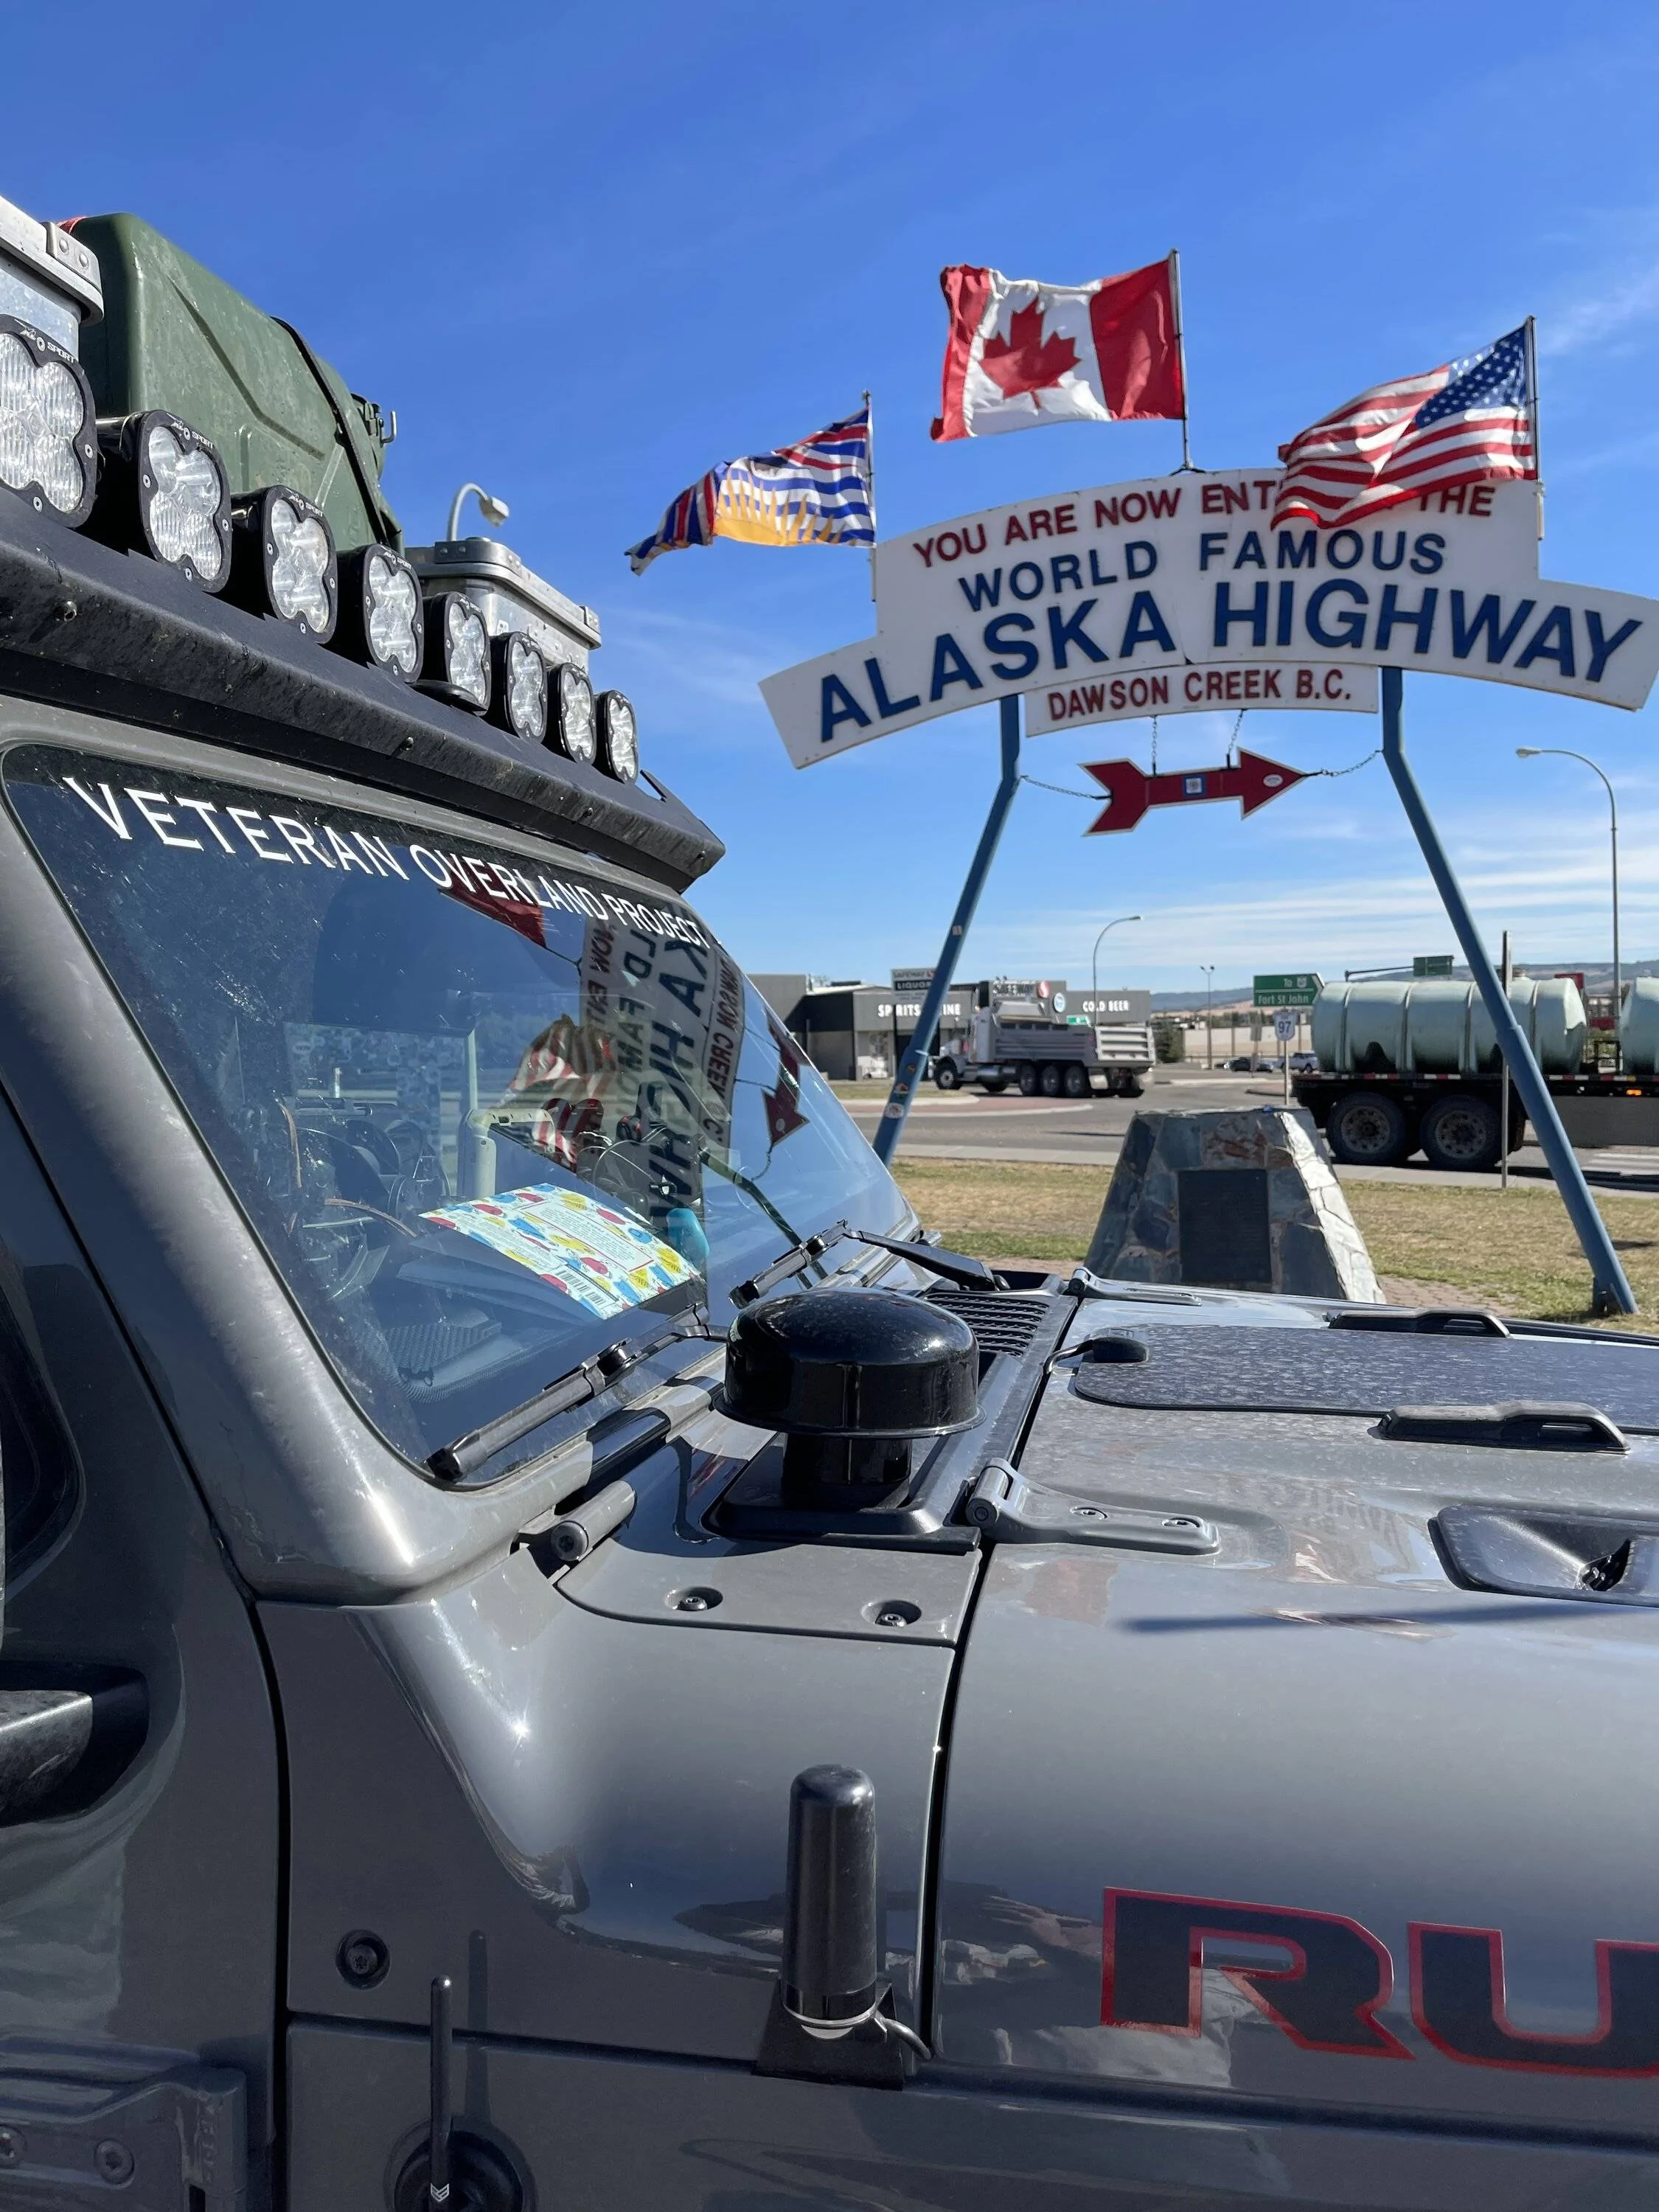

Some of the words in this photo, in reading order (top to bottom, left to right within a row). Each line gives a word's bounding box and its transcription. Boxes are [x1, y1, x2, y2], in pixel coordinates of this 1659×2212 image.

[47, 341, 74, 364] SPORT
[192, 431, 213, 449] SPORT
[913, 523, 987, 568] YOU
[1004, 504, 1078, 541] ARE
[1093, 487, 1182, 527] NOW
[958, 540, 1158, 613] WORLD
[1199, 529, 1447, 575] FAMOUS
[820, 590, 1177, 744] ALASKA
[1213, 578, 1644, 683] HIGHWAY
[1048, 675, 1169, 720] DAWSON
[1184, 669, 1282, 702] CREEK
[1295, 669, 1352, 700] B.C.
[62, 776, 411, 881] VETERAN
[409, 844, 610, 921] OVERLAND
[602, 892, 711, 950] PROJECT
[878, 1004, 921, 1017] SPRITS
[1258, 994, 1276, 1004] Fort
[1278, 994, 1286, 1004] St
[1288, 993, 1309, 1004] John
[1278, 1020, 1292, 1033] 97
